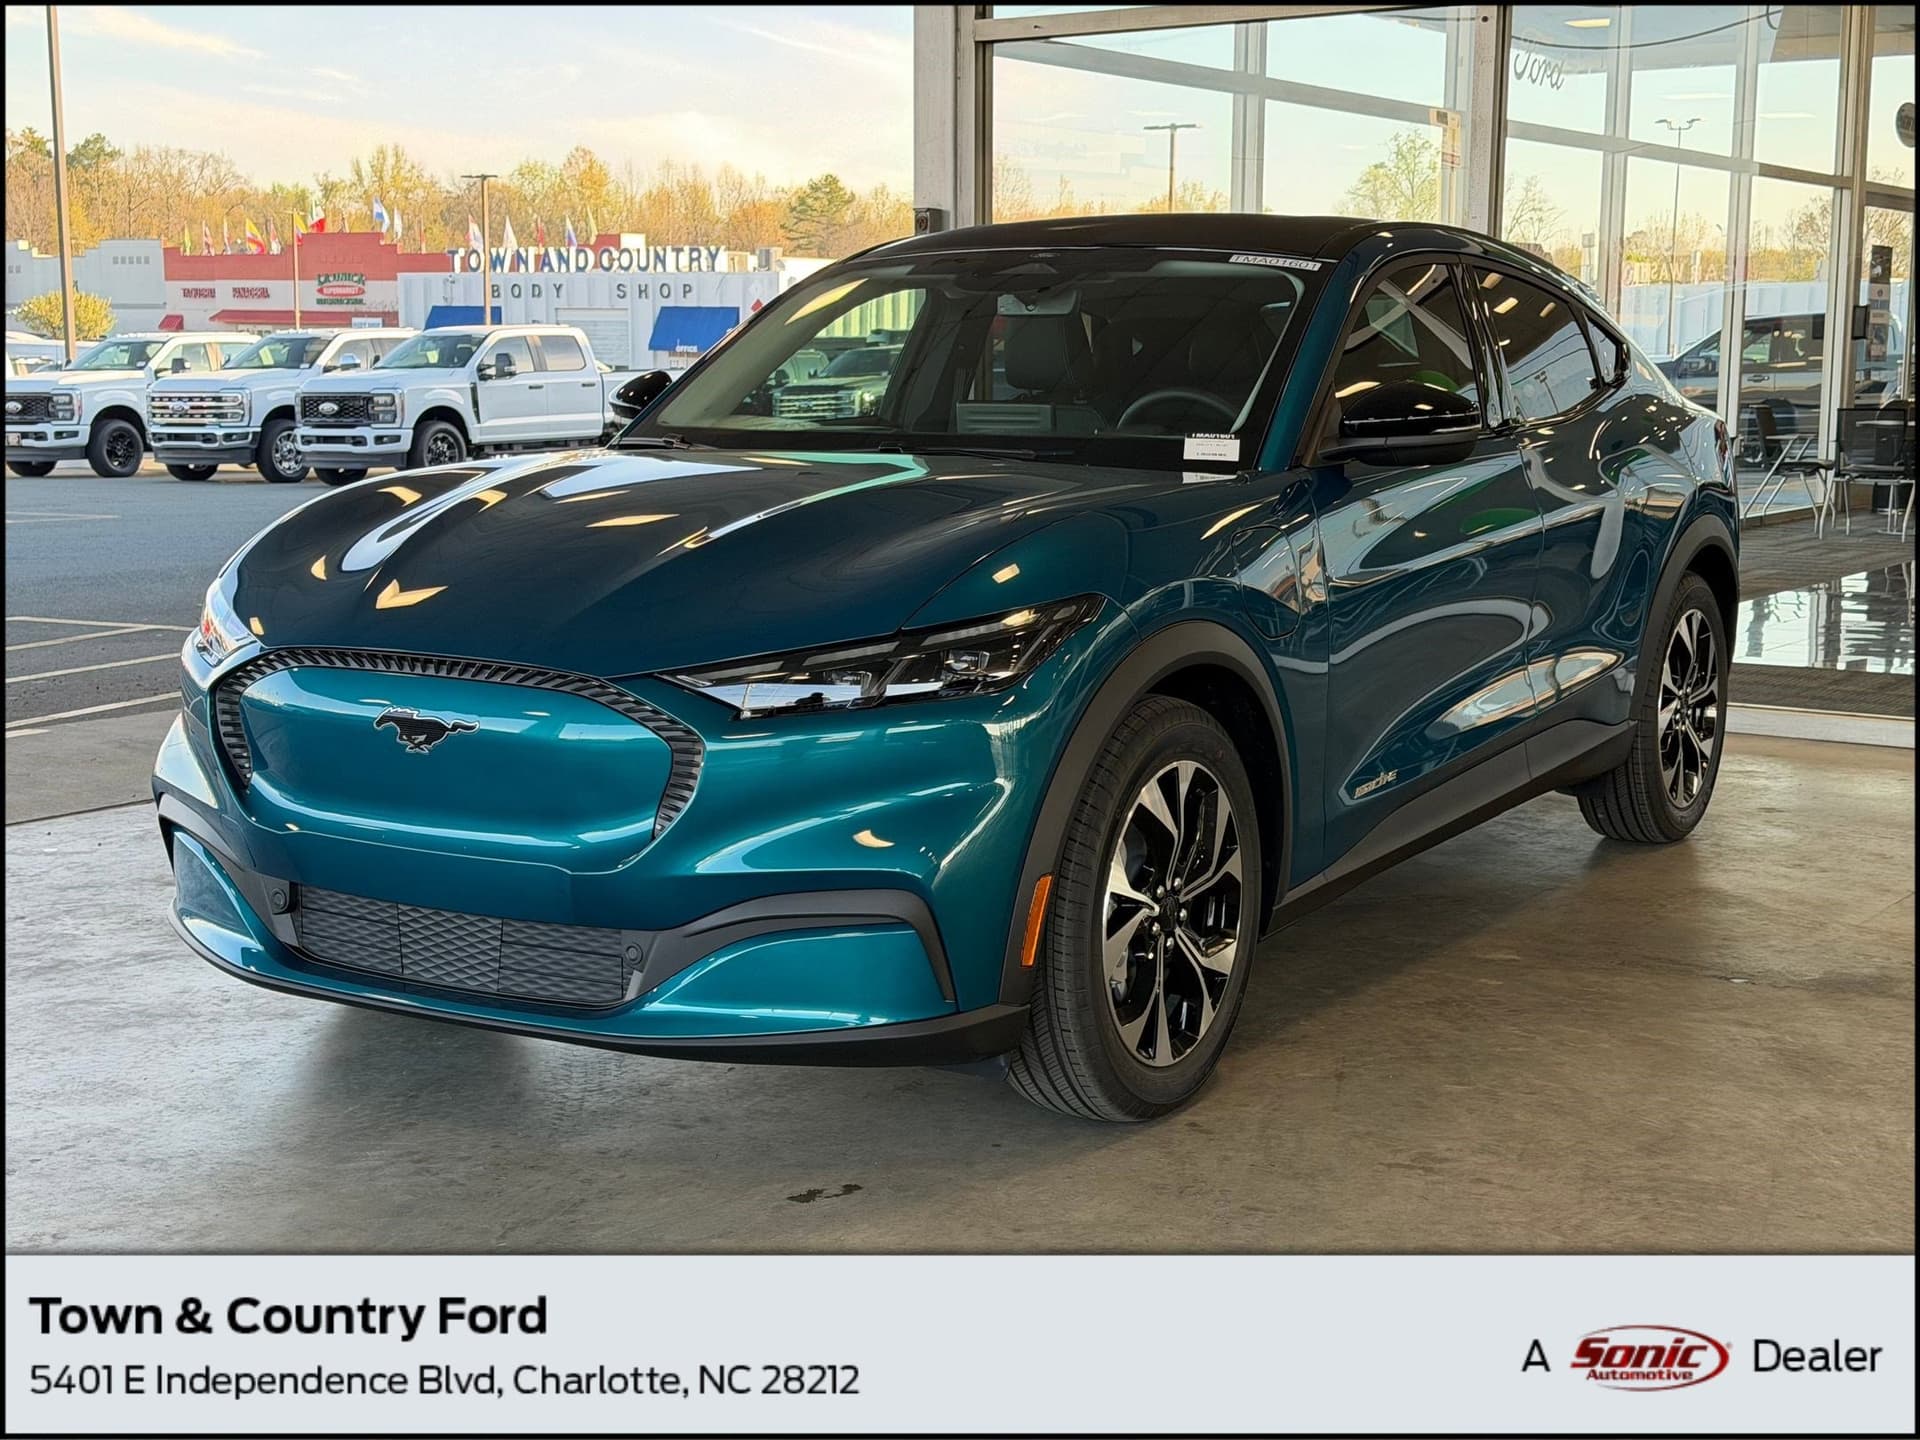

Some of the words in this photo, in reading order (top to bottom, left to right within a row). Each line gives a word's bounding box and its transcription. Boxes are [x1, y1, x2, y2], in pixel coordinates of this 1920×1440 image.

[447, 247, 529, 272] TOWN
[541, 247, 589, 272] AND
[600, 247, 720, 272] COUNTRY
[491, 283, 564, 299] BODY
[616, 283, 693, 299] SHOP
